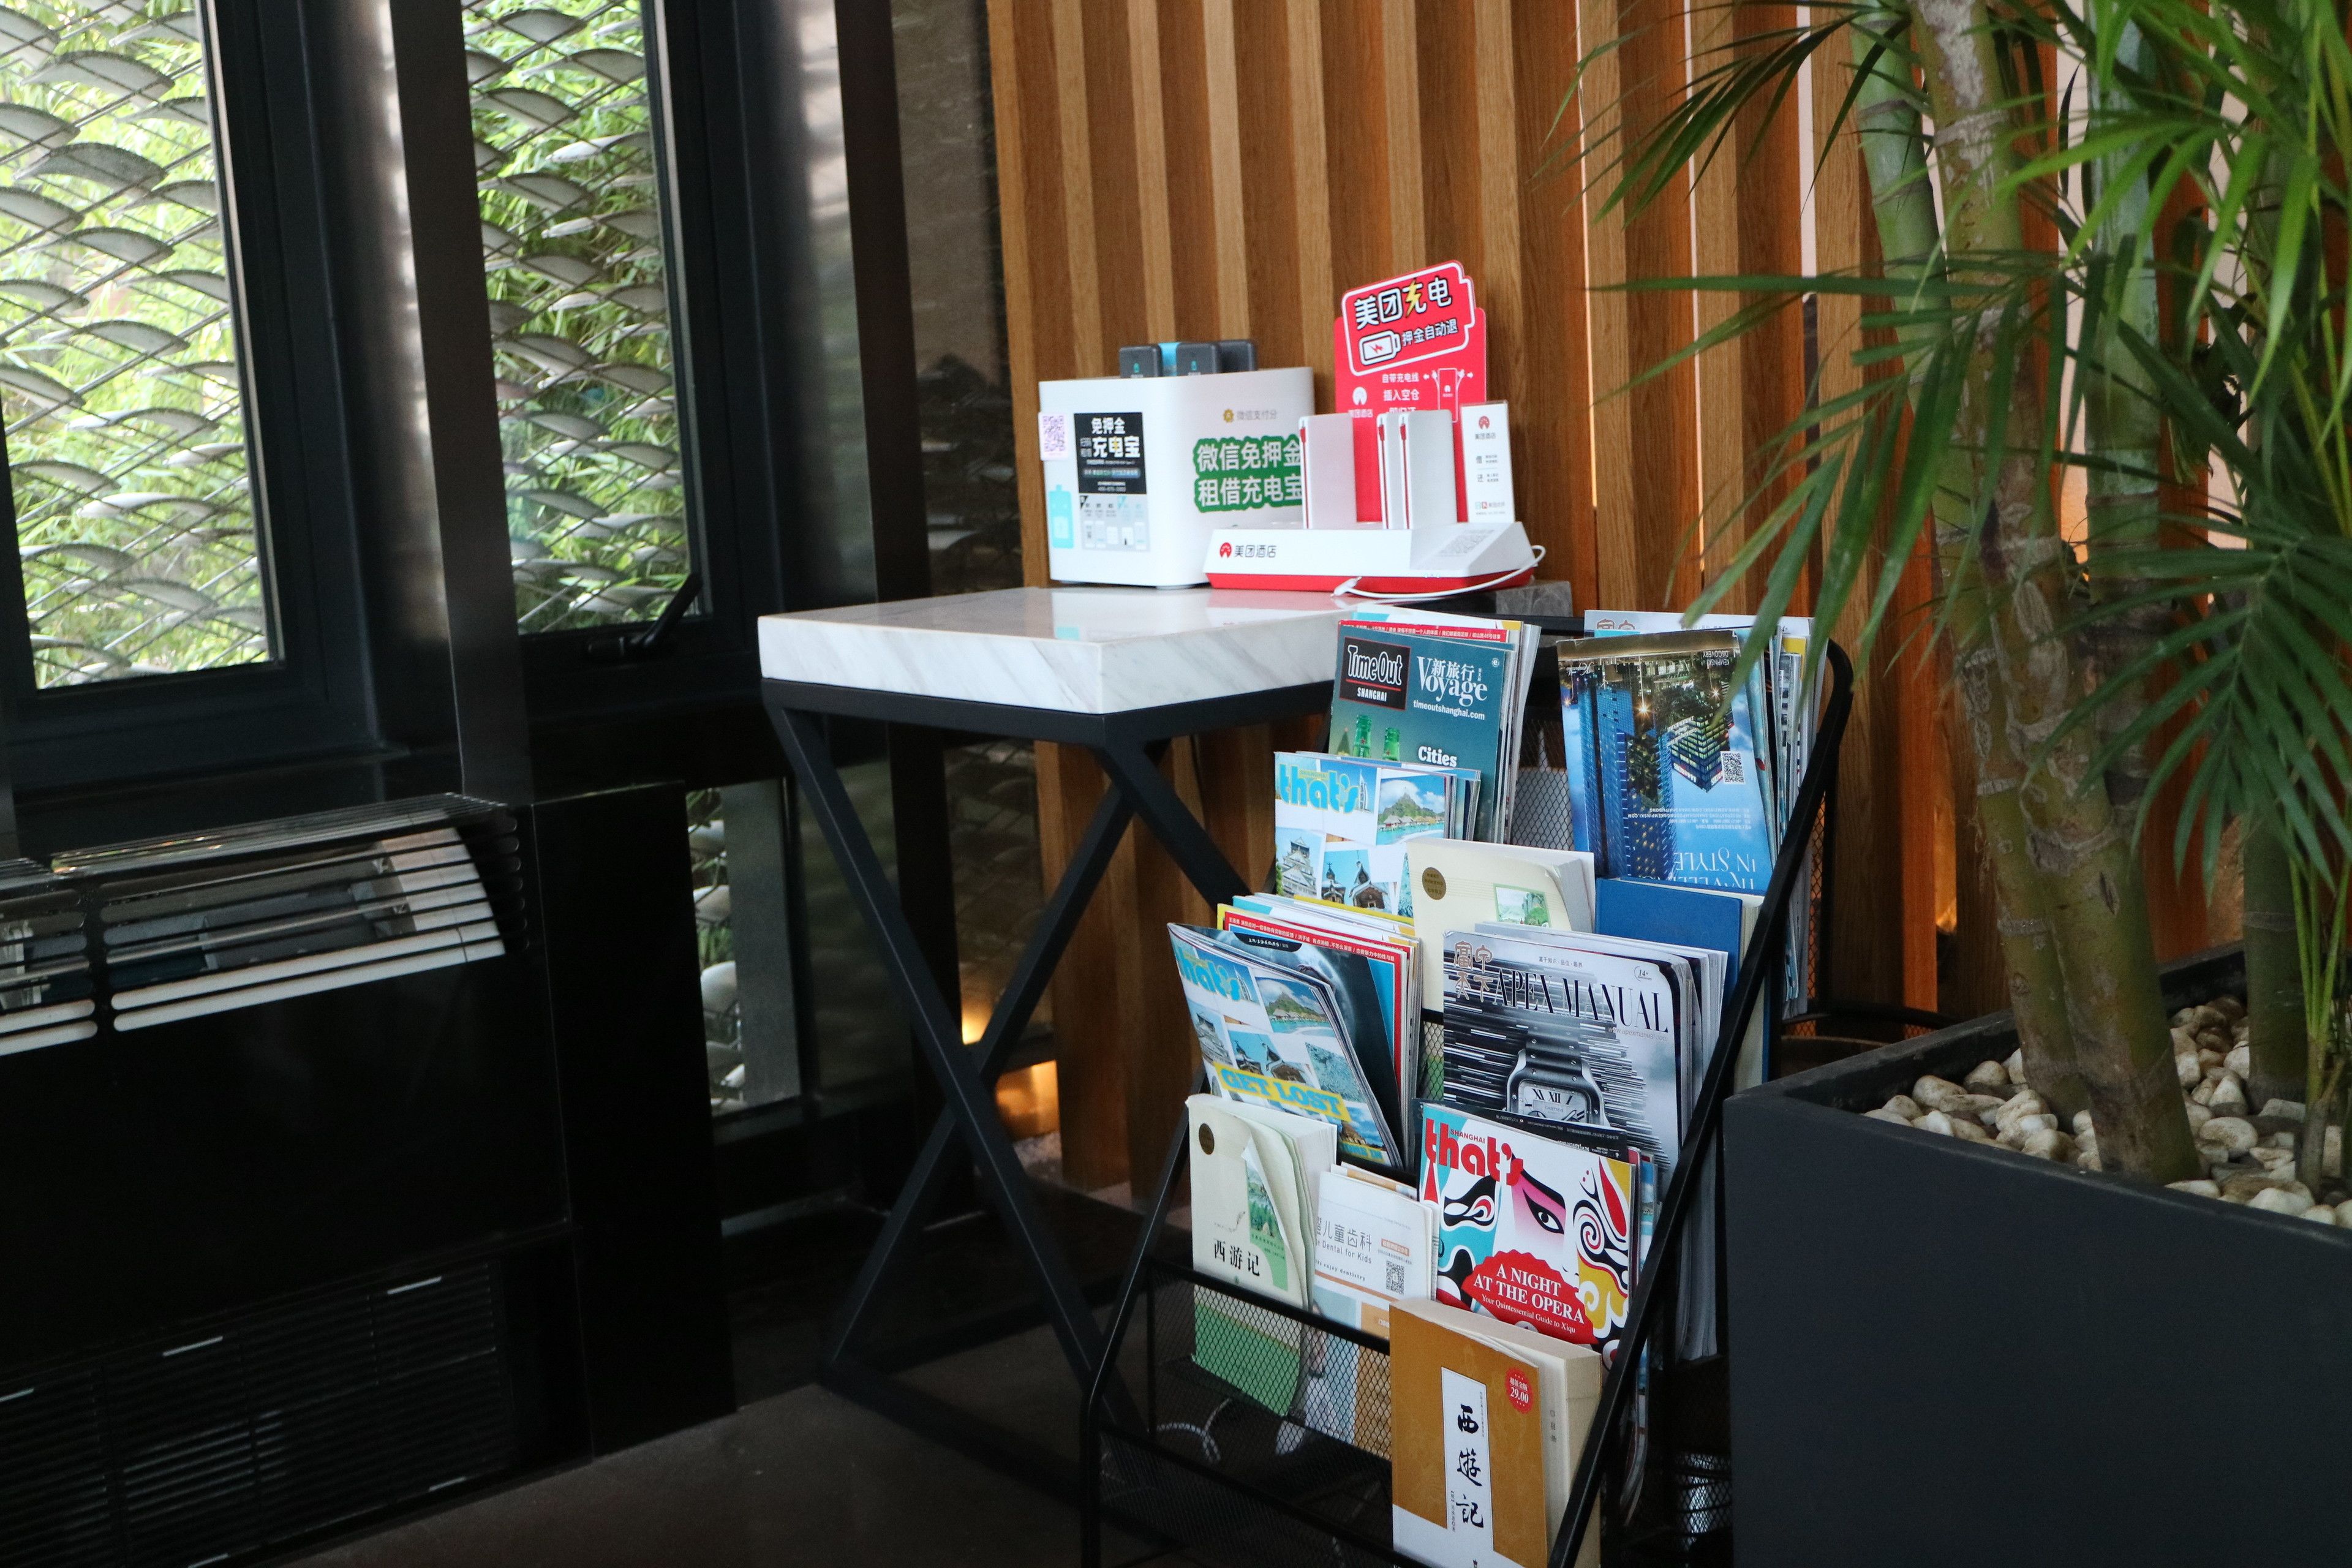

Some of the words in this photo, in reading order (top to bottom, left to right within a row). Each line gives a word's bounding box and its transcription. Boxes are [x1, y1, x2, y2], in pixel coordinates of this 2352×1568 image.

[1354, 277, 1452, 330] 美团充电
[1401, 318, 1458, 347] 押金自动退
[1382, 372, 1419, 383] 自带充电线
[1384, 389, 1420, 401] 插入空仓
[1091, 417, 1126, 434] 免押金
[1092, 435, 1140, 458] 充电宝
[1197, 439, 1300, 472] 微信免押金
[1197, 474, 1302, 507] 租借充电宝
[1235, 545, 1276, 558] 美团酒店
[1348, 645, 1378, 680] Time
[1378, 651, 1403, 685] Out
[1431, 658, 1474, 682] 新旅行
[1357, 687, 1387, 702] SHANGHAI
[1417, 656, 1488, 707] Voyage
[1413, 700, 1485, 720] timeoutshanghai.com
[1418, 745, 1457, 767] Cities
[1279, 763, 1360, 814] that's
[1673, 847, 1730, 873] STYLE
[1492, 968, 1555, 1014] APEX
[1562, 978, 1668, 1033] MANUAL
[1608, 1027, 1668, 1041] www.apexmanual.com
[1221, 1068, 1271, 1096] GET
[1273, 1082, 1341, 1115] LOST
[1450, 1129, 1485, 1144] SHANGHAI
[1425, 1118, 1523, 1186] that's
[1213, 1238, 1260, 1276] 西游记
[1322, 1240, 1343, 1255] Dental
[1346, 1248, 1355, 1257] for
[1357, 1252, 1372, 1264] Kids
[1324, 1264, 1337, 1272] enjoy
[1340, 1268, 1365, 1281] dentistry
[1496, 1264, 1507, 1280] A
[1510, 1267, 1561, 1297] NIGHT
[1474, 1274, 1493, 1291] AT
[1496, 1280, 1528, 1305] THE
[1531, 1293, 1585, 1324] OPERA
[1482, 1294, 1494, 1305] Your
[1495, 1300, 1534, 1319] Quintessential
[1535, 1314, 1553, 1325] Guide
[1561, 1322, 1575, 1333] Xiqu
[1510, 1387, 1529, 1403] 29.00
